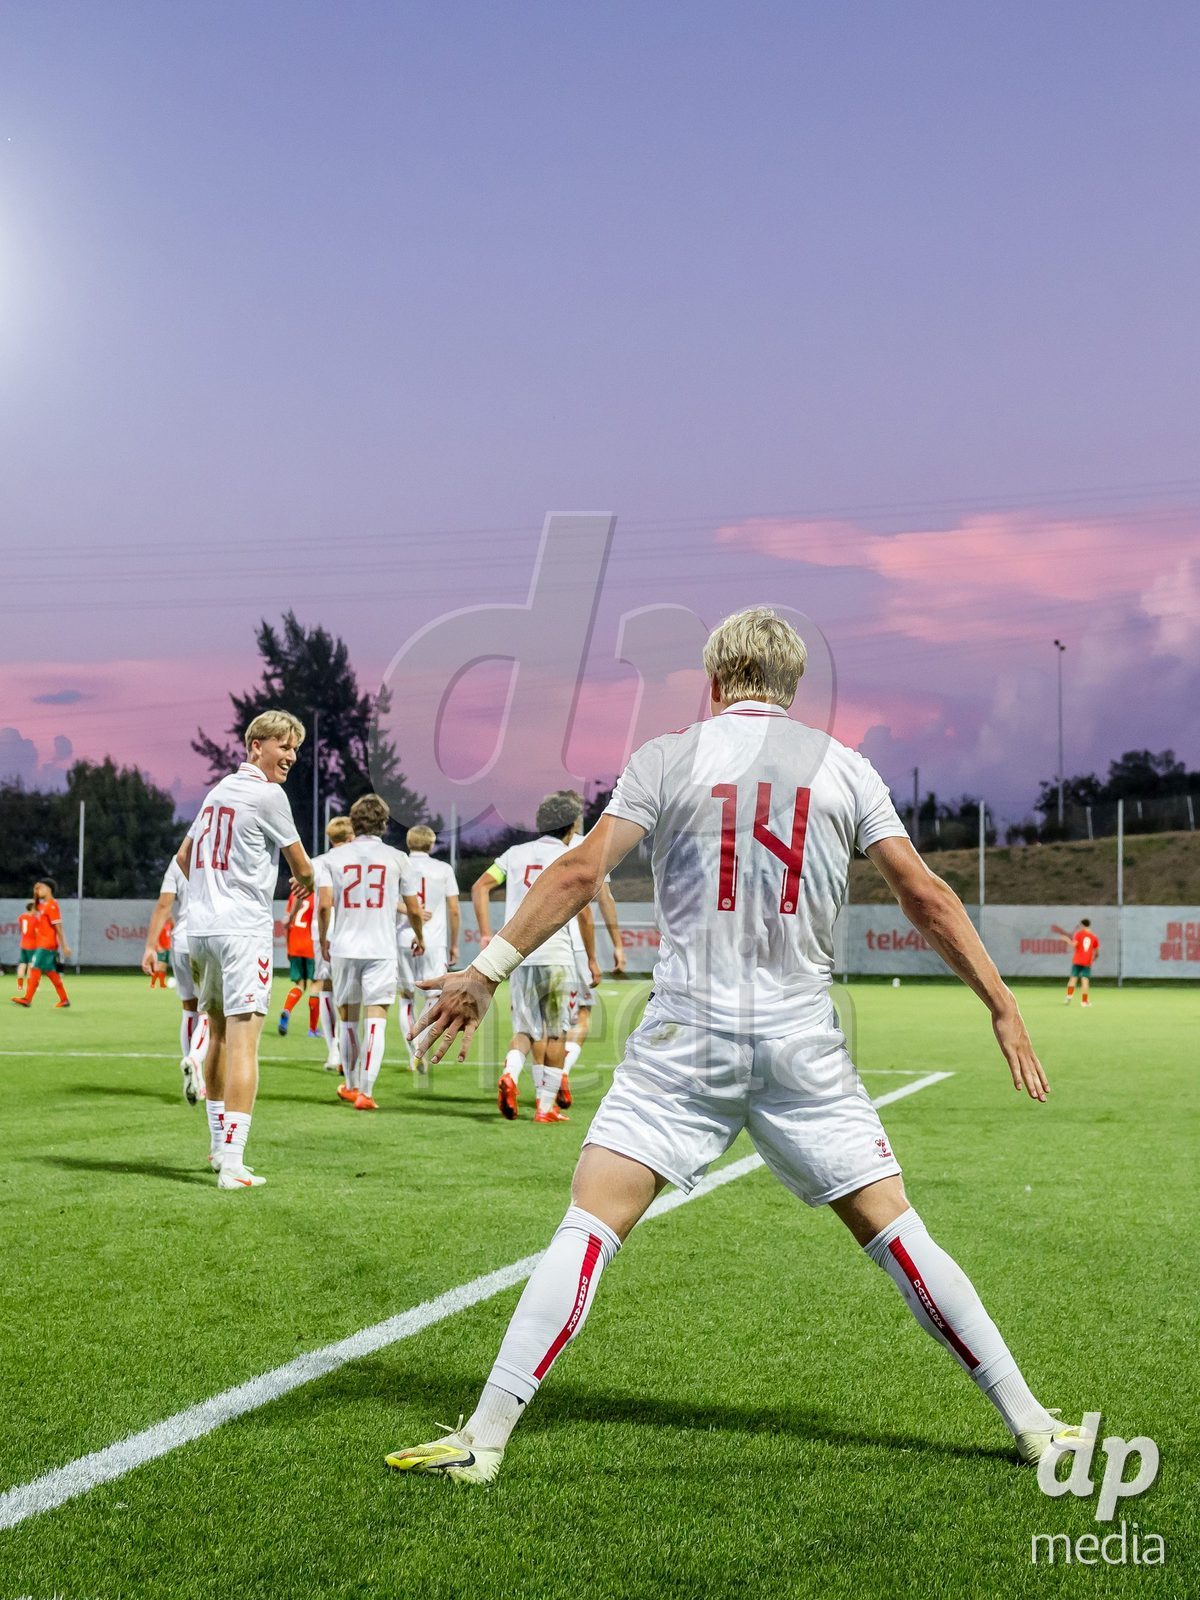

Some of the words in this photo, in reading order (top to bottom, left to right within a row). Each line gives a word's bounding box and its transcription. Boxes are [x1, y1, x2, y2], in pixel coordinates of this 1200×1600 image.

[196, 806, 235, 870] 20
[711, 782, 811, 914] 14
[343, 864, 386, 908] 23
[1020, 938, 1068, 955] PUMA
